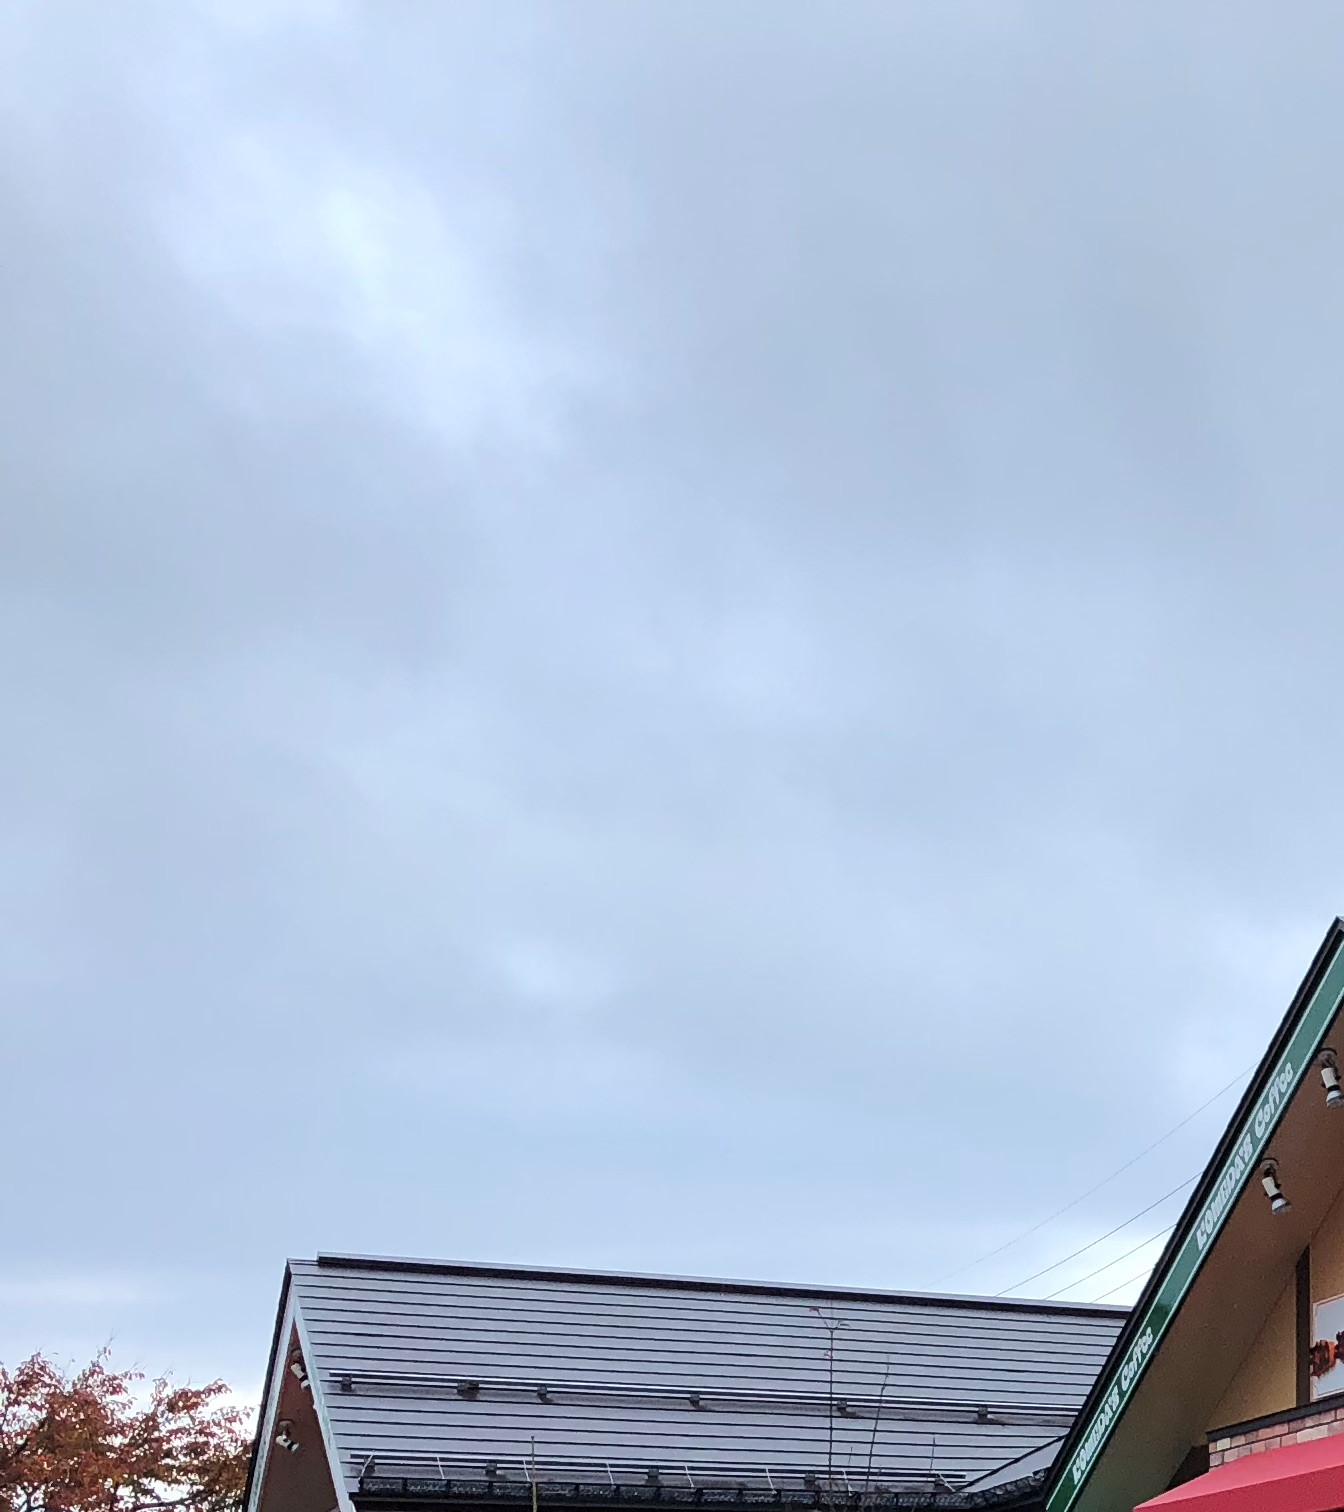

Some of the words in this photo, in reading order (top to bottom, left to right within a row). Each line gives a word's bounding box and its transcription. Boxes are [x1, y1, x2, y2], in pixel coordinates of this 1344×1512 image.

[1195, 1132, 1254, 1251] KOMEDA'S
[1254, 1062, 1294, 1138] Coffee
[1121, 1326, 1154, 1392] Coffee
